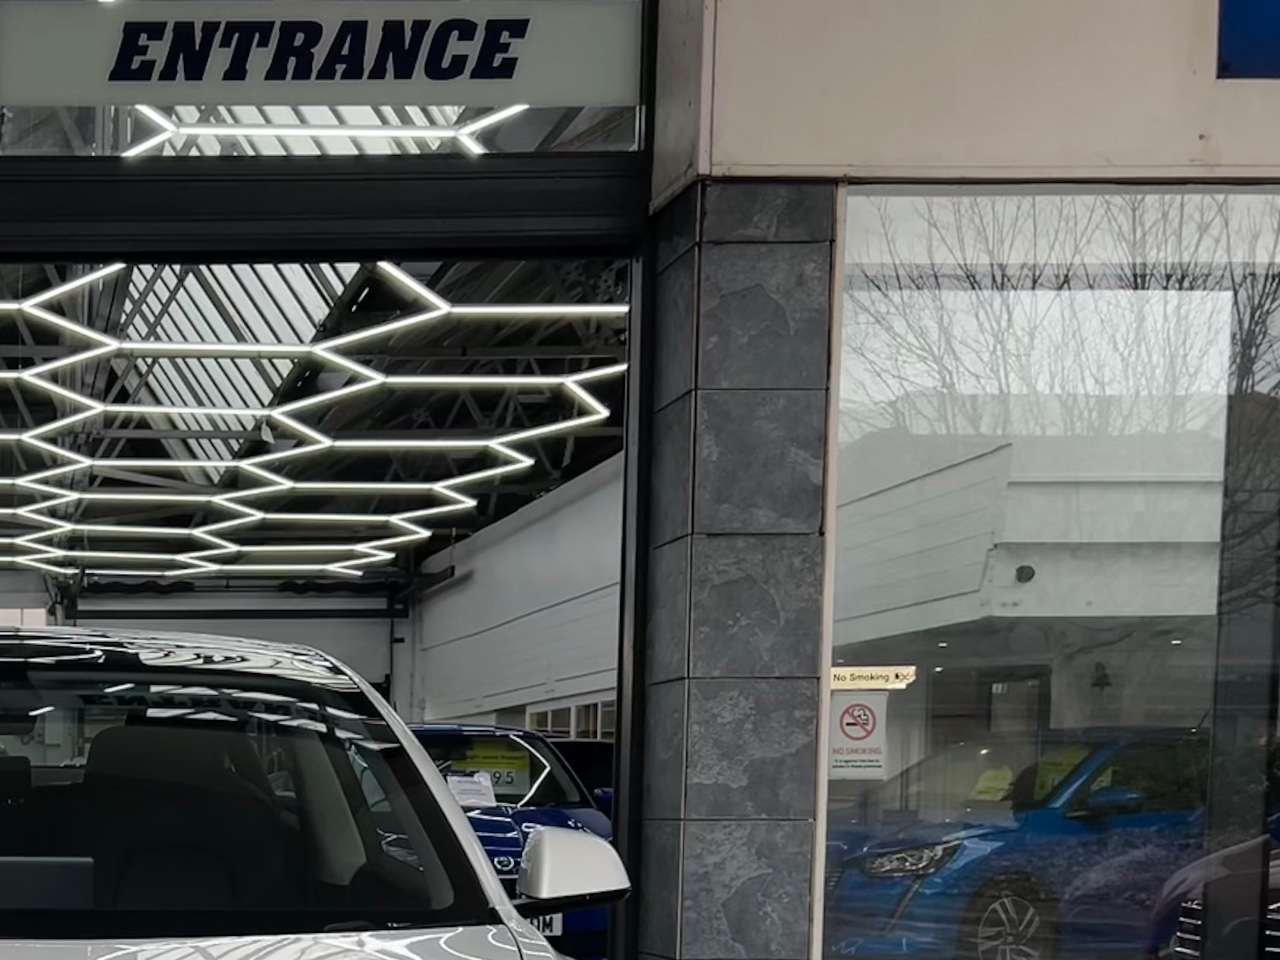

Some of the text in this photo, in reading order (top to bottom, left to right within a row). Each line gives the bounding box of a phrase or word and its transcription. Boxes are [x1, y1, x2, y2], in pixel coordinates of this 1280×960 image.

[108, 19, 530, 81] ENTRANCE
[833, 672, 889, 683] No Smoking
[492, 770, 515, 785] 95
